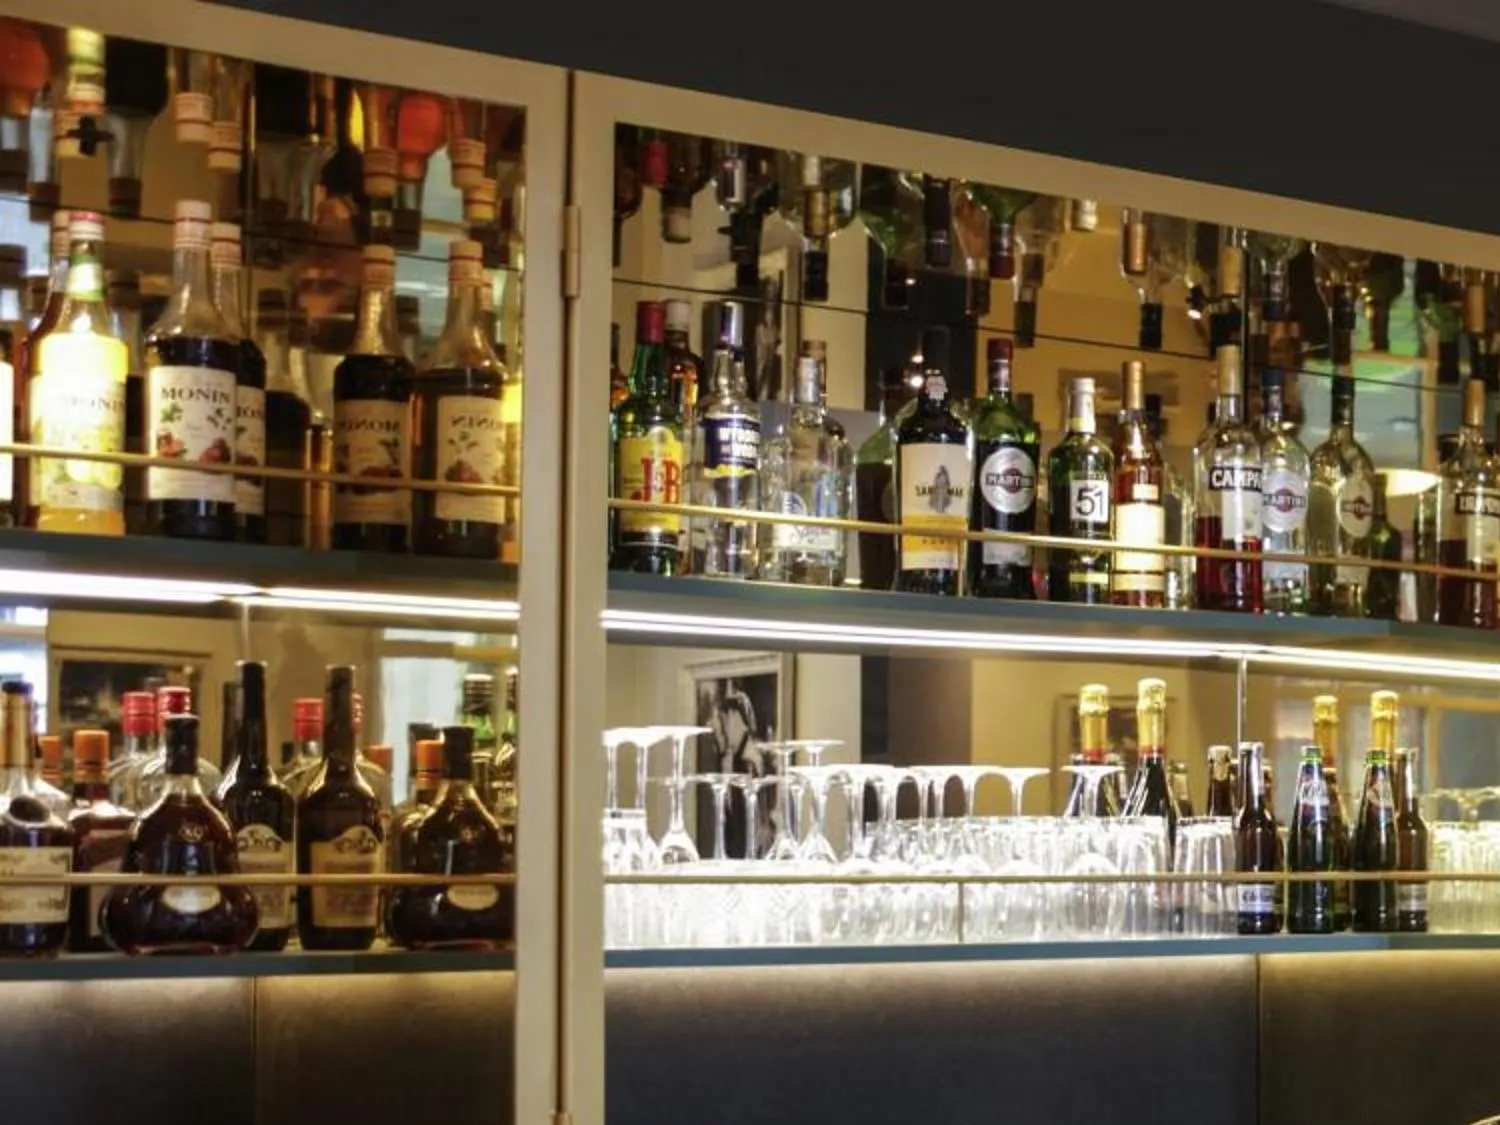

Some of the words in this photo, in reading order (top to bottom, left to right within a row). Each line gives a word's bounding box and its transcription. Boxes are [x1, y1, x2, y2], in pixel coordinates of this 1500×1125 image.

[162, 387, 230, 405] MONIN
[986, 473, 1034, 489] MART
[1212, 469, 1262, 489] CAMPA
[915, 485, 963, 498] SANMAN
[1076, 486, 1105, 518] 51
